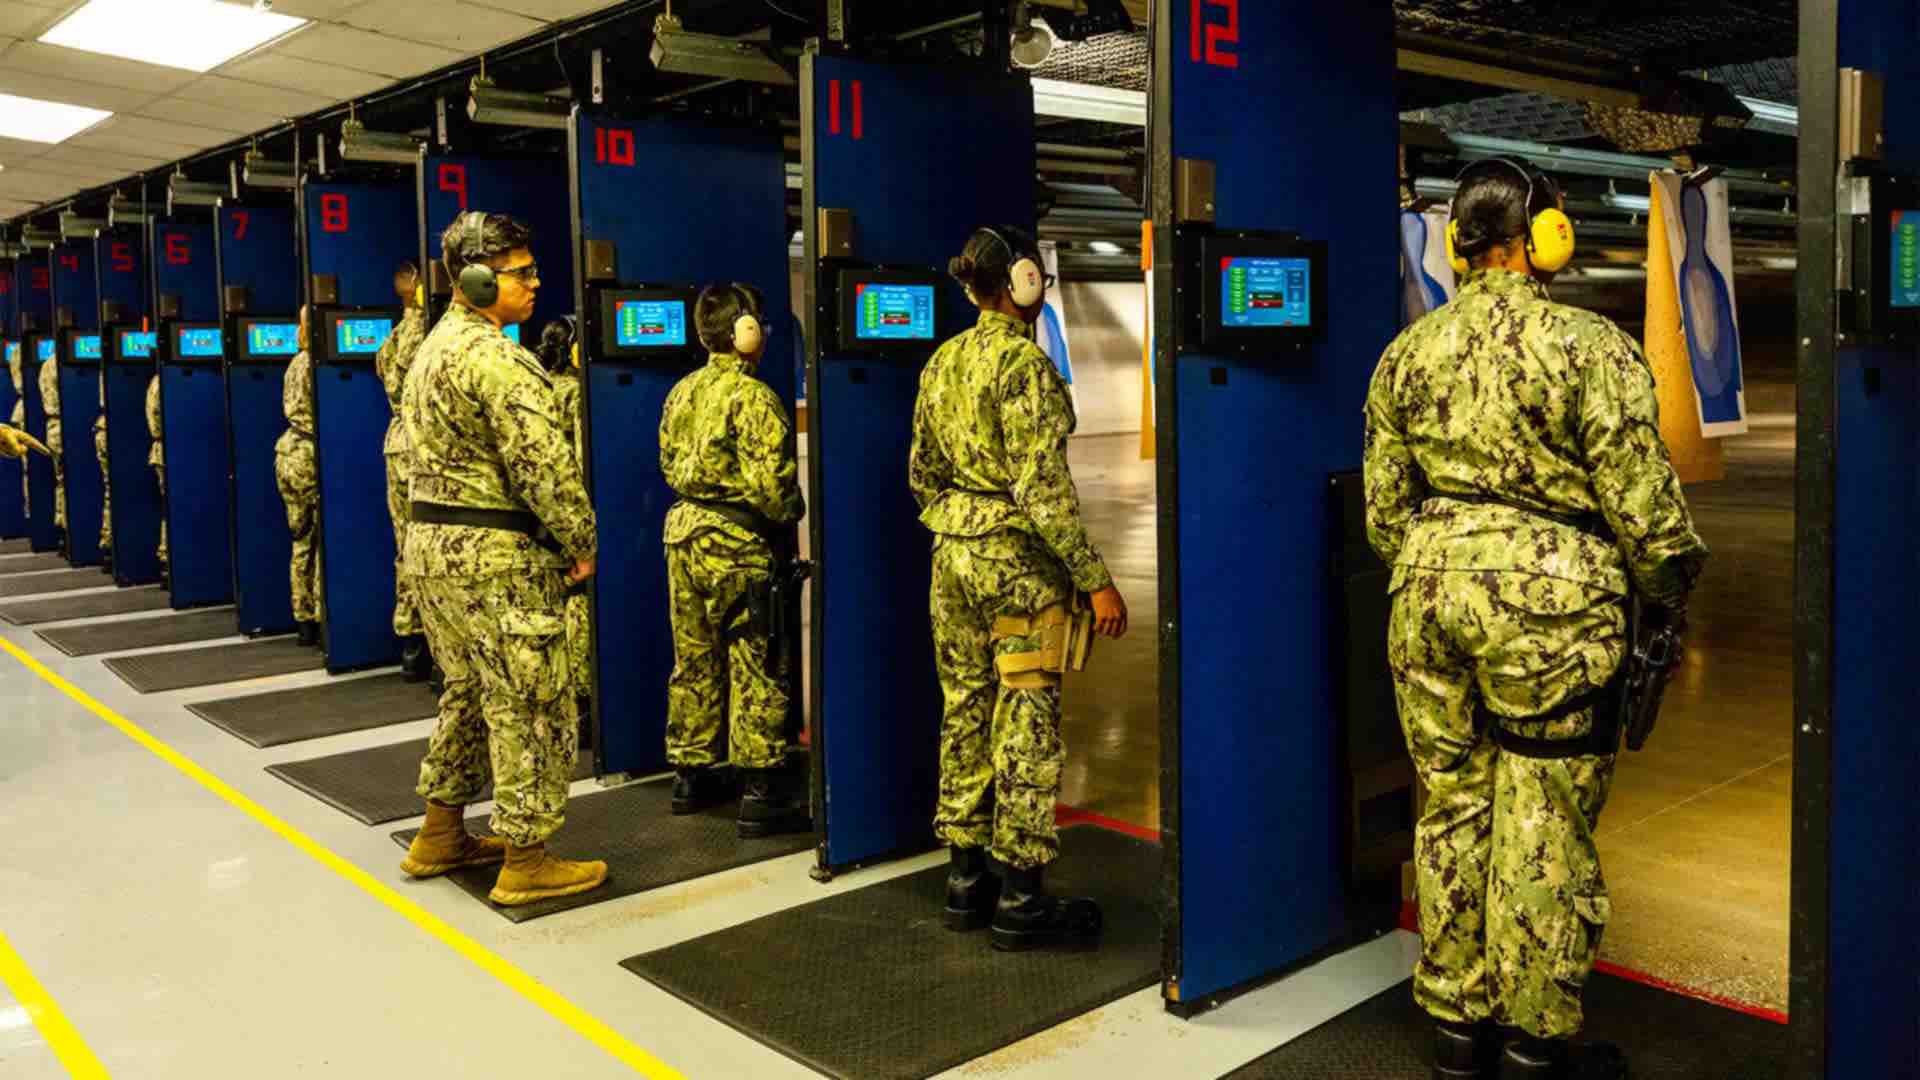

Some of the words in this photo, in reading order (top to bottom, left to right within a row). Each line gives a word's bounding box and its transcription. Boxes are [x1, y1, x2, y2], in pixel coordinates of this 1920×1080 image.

[1190, 0, 1239, 68] 12
[829, 80, 863, 139] 11
[595, 128, 635, 166] 10
[438, 163, 468, 210] 9
[232, 211, 249, 240] 7
[320, 193, 349, 233] 8
[60, 255, 79, 273] 4
[112, 242, 133, 272] 5
[165, 233, 192, 264] 6
